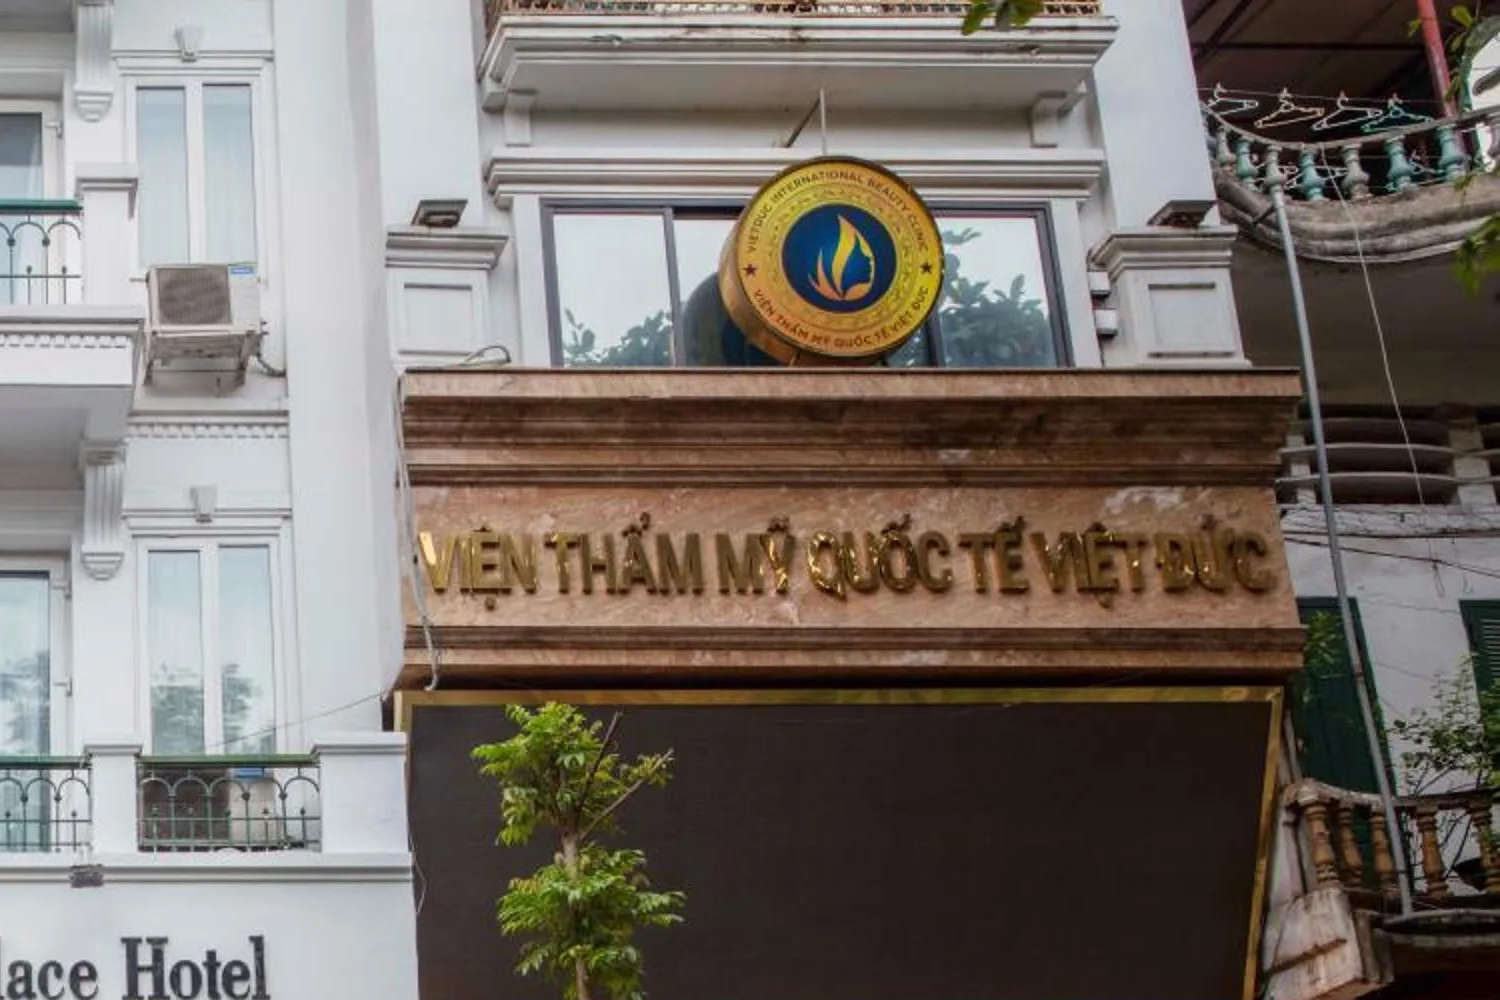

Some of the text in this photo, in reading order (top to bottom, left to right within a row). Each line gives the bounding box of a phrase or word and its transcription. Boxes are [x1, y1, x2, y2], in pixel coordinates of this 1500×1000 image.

[771, 170, 863, 207] INTERNATIONAL
[867, 177, 907, 213] BEAUTY
[419, 512, 1276, 610] VIỆN THẨM MỸ QUỐC TẾ VIỆT ĐỨC
